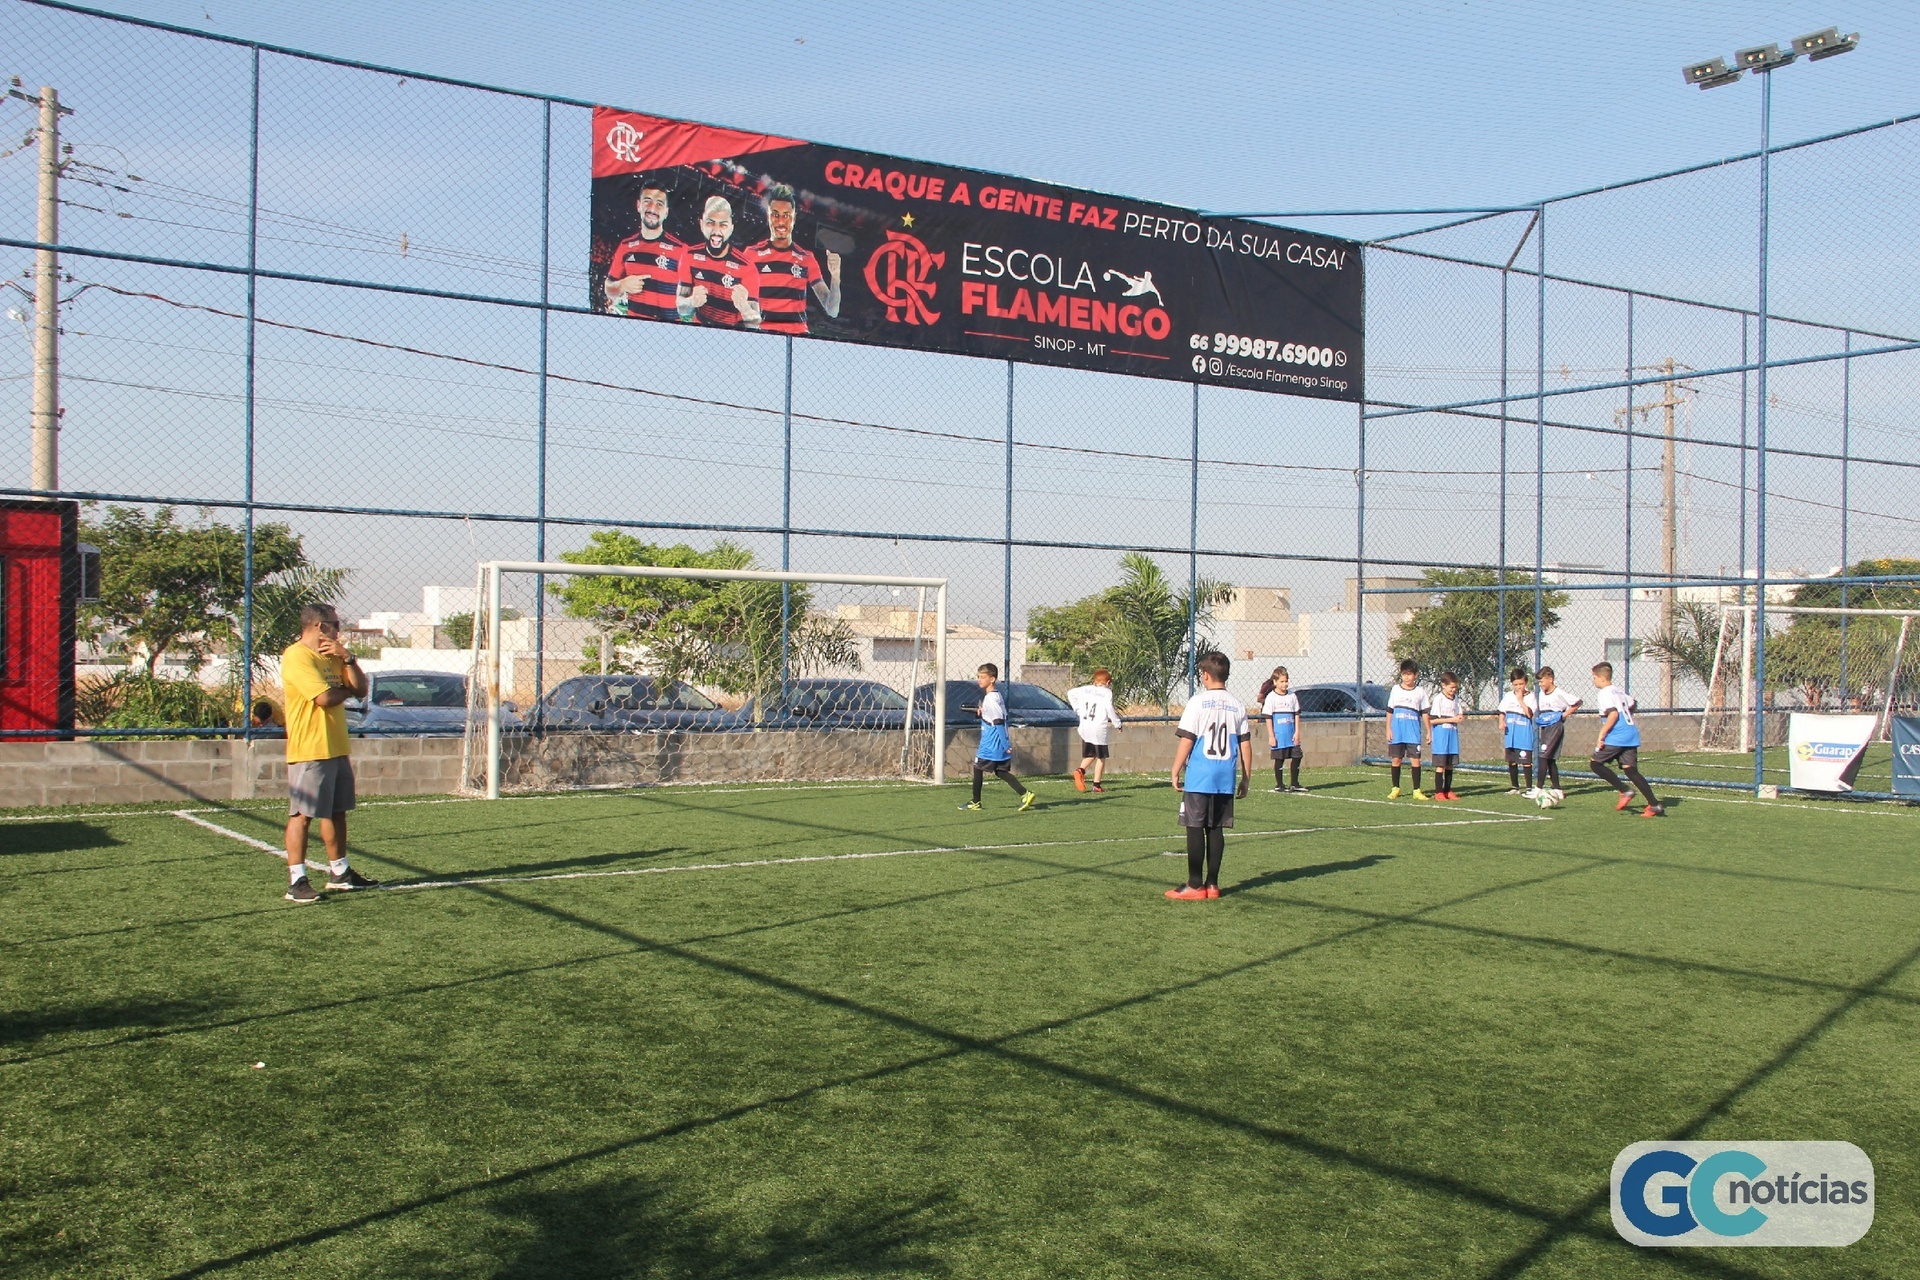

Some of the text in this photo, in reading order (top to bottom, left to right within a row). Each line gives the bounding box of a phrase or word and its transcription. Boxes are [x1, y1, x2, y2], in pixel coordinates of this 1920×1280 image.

[825, 160, 1346, 271] CRAQUE A GENTE FAZ PERTO DA SUA CASA!
[962, 242, 1096, 292] ESCOLA
[961, 281, 1171, 340] FLAMENGO
[1033, 335, 1076, 352] SINOP
[1087, 342, 1106, 356] MT
[1189, 332, 1333, 368] 66 99987.6900
[1224, 362, 1348, 391] /Escola Flamengo Sinop
[1083, 701, 1097, 722] 14
[1207, 721, 1227, 757] 10
